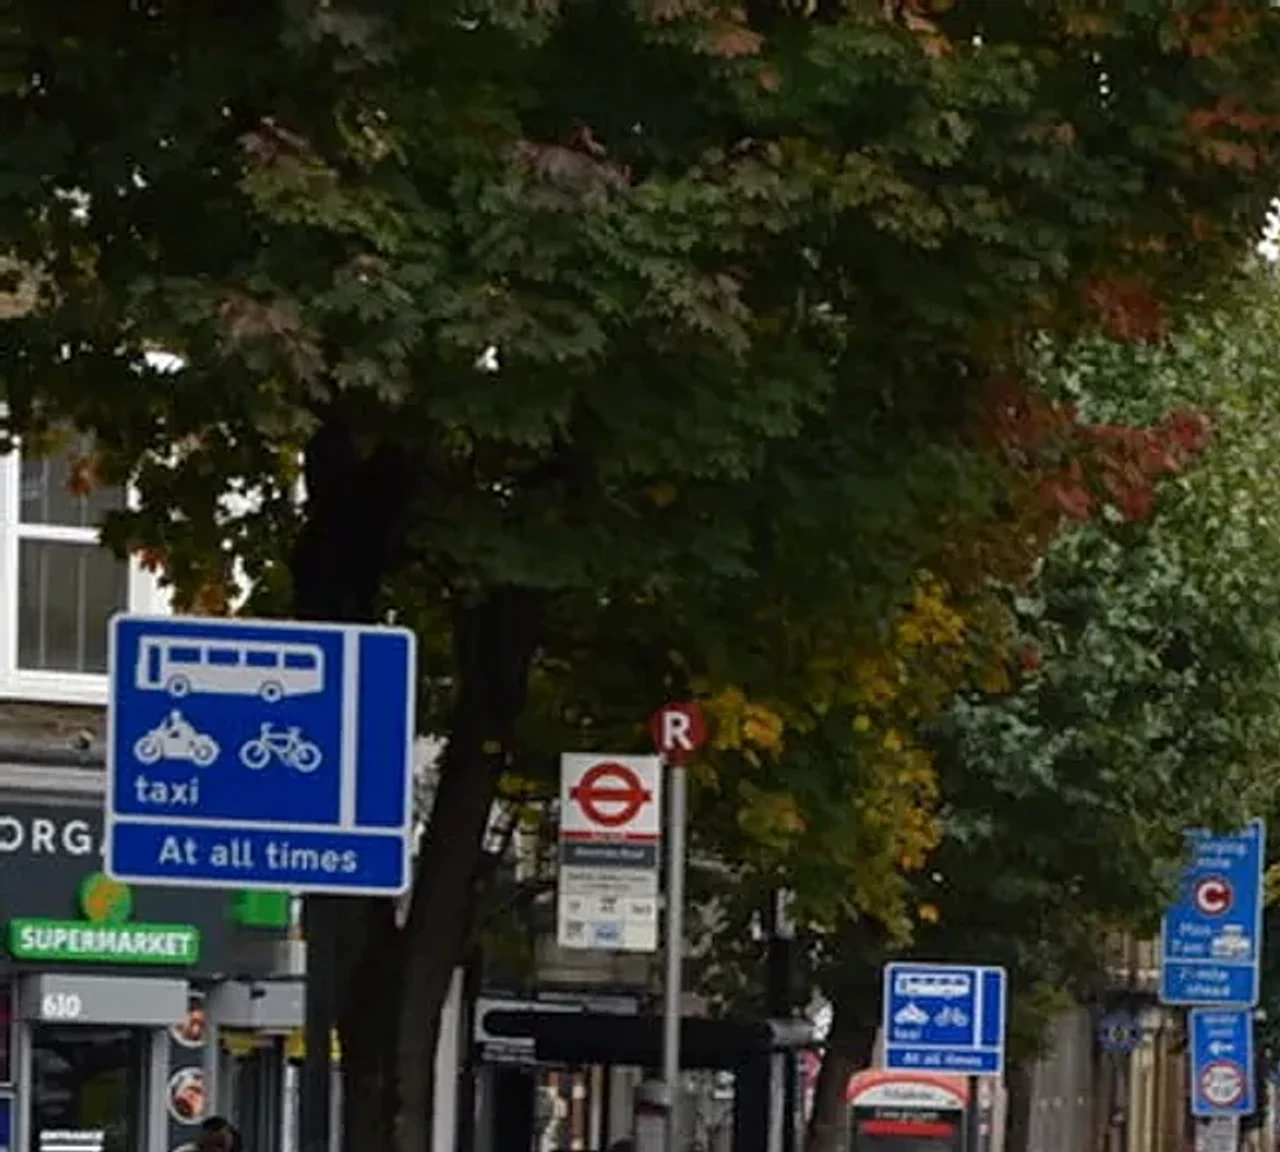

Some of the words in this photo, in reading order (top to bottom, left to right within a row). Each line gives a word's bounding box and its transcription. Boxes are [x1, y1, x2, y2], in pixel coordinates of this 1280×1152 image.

[663, 711, 693, 750] R
[133, 775, 200, 804] taxi
[0, 816, 105, 856] ORG
[158, 836, 198, 867] At
[209, 838, 253, 868] all
[265, 841, 358, 873] times
[19, 926, 192, 957] SUPERMARKET
[41, 993, 83, 1018] 610
